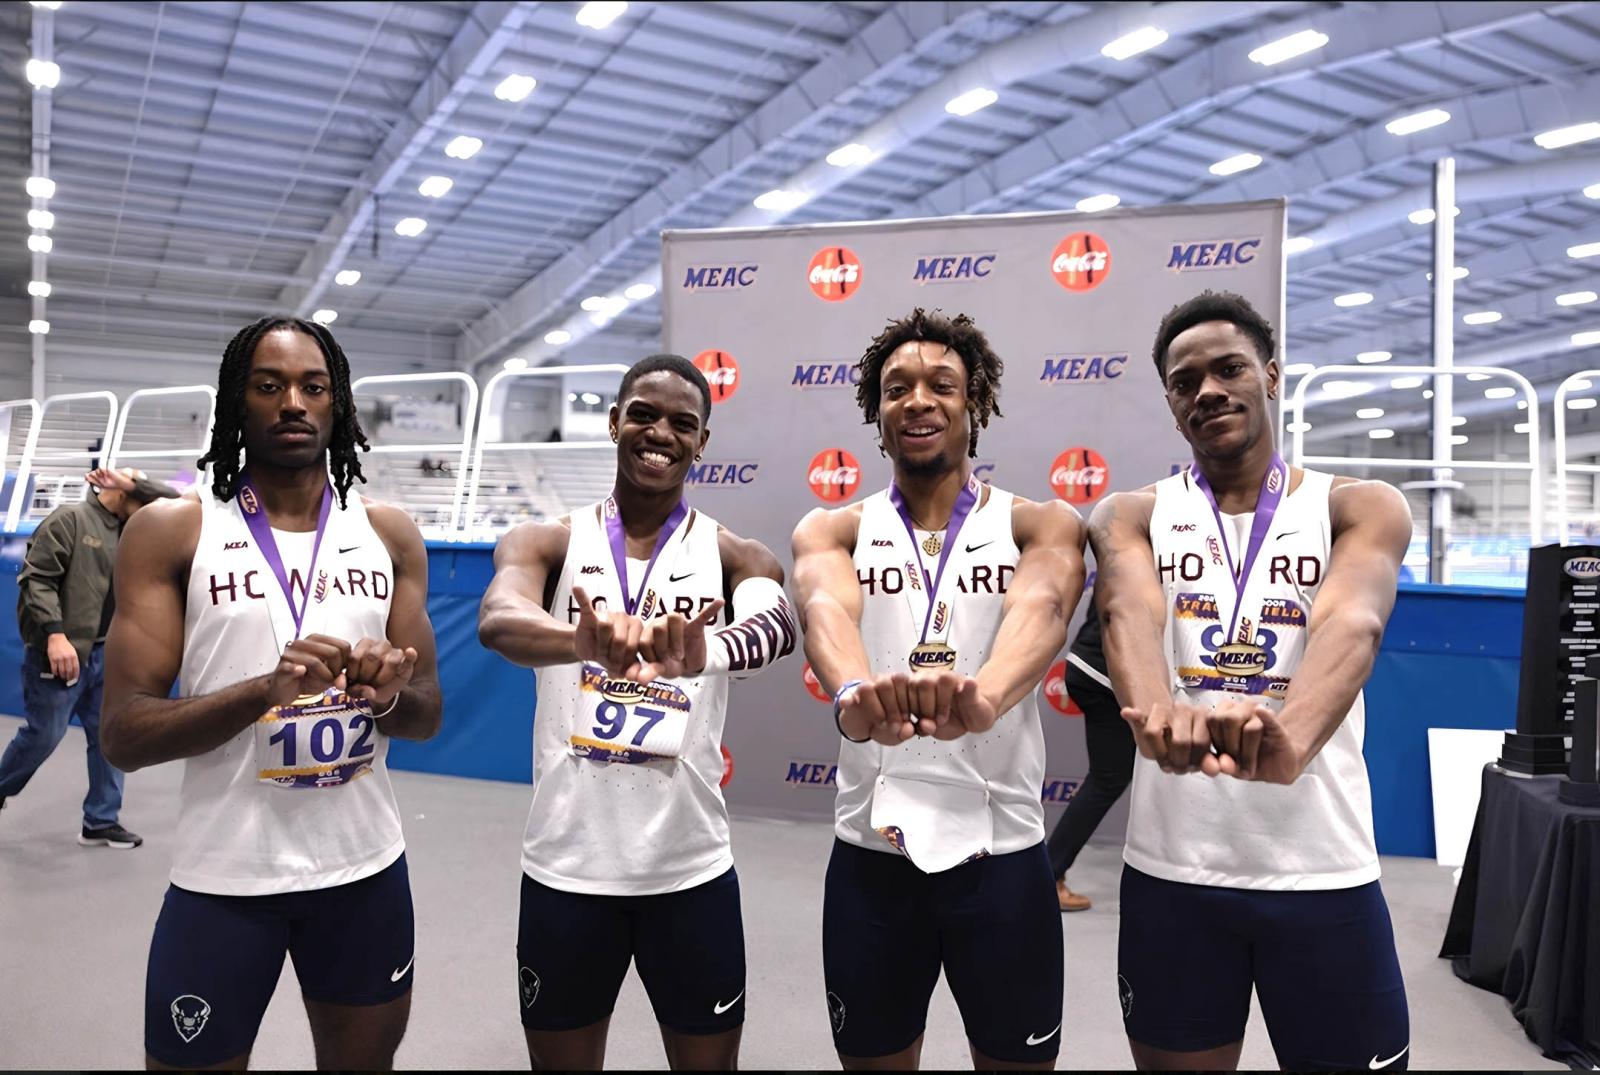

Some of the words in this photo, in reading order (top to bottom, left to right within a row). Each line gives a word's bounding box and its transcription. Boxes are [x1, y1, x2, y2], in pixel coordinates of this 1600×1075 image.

[1167, 239, 1261, 268] MEAC
[683, 265, 758, 288] MEAC
[913, 254, 997, 280] MEAC
[1040, 355, 1128, 381] MEAC
[685, 464, 758, 484] MEAC
[224, 541, 248, 550] MEA
[1158, 552, 1321, 587] HORD
[914, 651, 956, 664] MEAC
[1217, 652, 1266, 665] MEAC
[604, 681, 645, 694] MEAC
[592, 699, 665, 746] 97
[270, 712, 374, 766] 102
[785, 763, 838, 785] MEA
